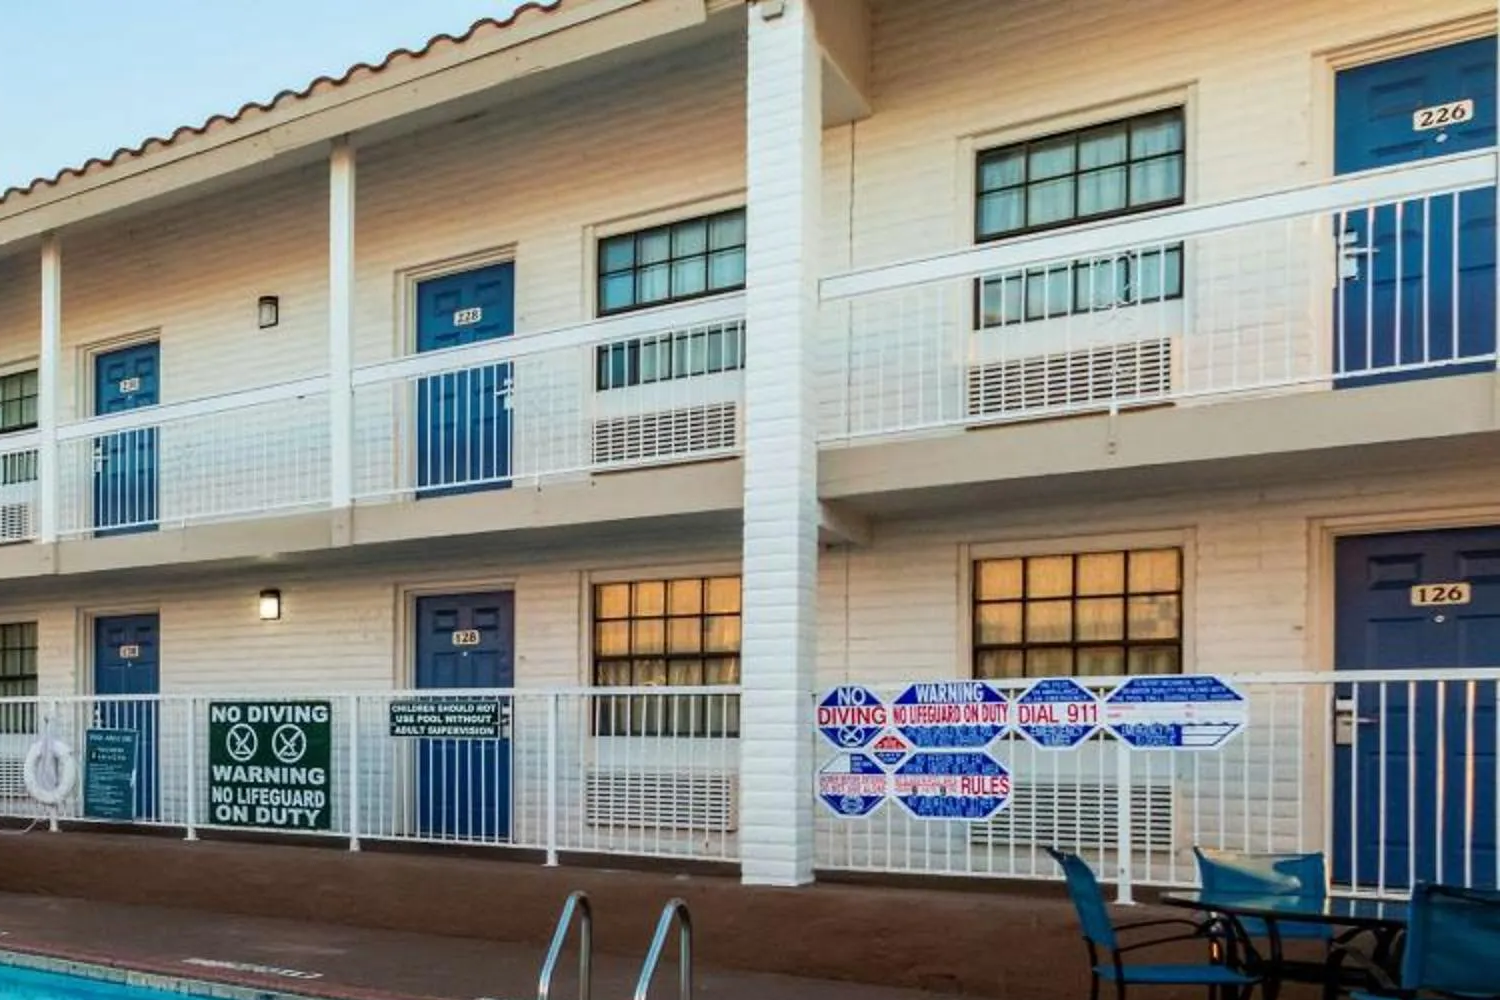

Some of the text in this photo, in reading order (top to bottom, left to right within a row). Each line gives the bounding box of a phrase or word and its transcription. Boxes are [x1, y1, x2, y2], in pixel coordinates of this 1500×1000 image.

[1420, 104, 1466, 127] 226
[1419, 586, 1463, 602] 126
[837, 687, 866, 706] NO
[915, 683, 984, 704] WARNING
[211, 705, 329, 723] NO DIVING
[391, 703, 496, 713] CHILDREN SHOULD NOT
[818, 706, 887, 725] DIVING
[893, 703, 1009, 724] NO LIFEGUARD ON DUTY
[1018, 704, 1059, 724] DIAL
[1067, 703, 1098, 723] 911
[395, 714, 492, 723] USE POOL WITHOUT
[395, 725, 495, 735] ADULT SUPERVISION
[212, 765, 325, 785] WARNING
[960, 776, 1010, 796] RULES
[211, 785, 325, 808] NO LIFEGUARD
[215, 804, 320, 827] ON DUTY
